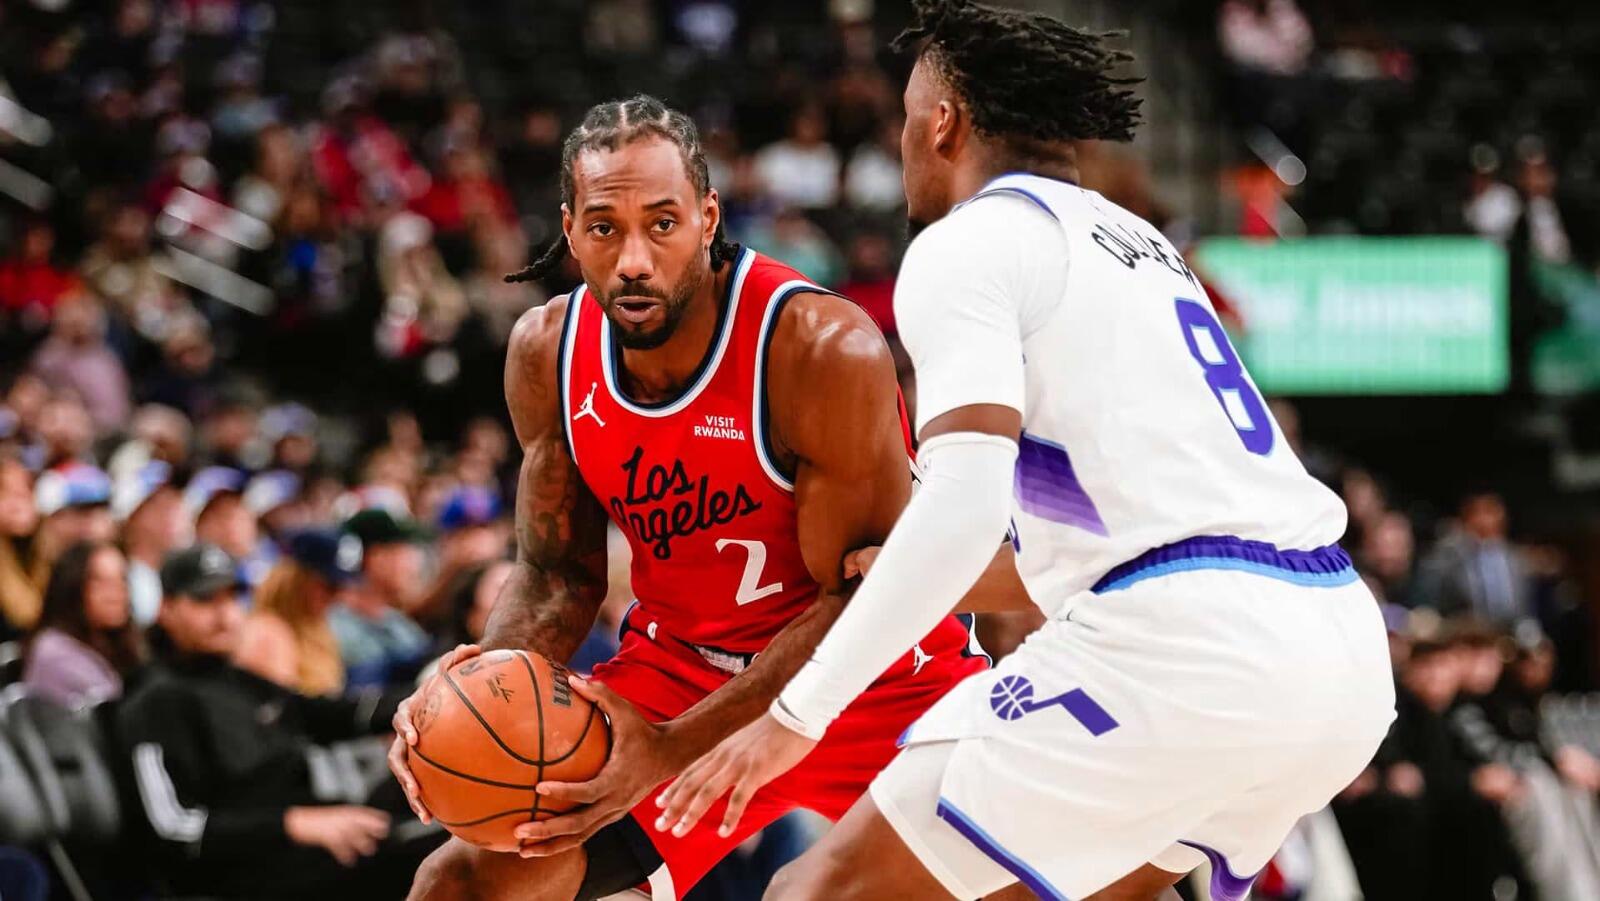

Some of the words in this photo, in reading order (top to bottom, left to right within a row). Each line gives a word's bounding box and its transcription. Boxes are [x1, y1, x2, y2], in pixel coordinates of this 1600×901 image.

[1174, 296, 1275, 458] 8
[693, 425, 746, 441] RWANDA
[705, 415, 735, 428] VISIT
[621, 445, 695, 505] Los
[715, 538, 783, 606] 2
